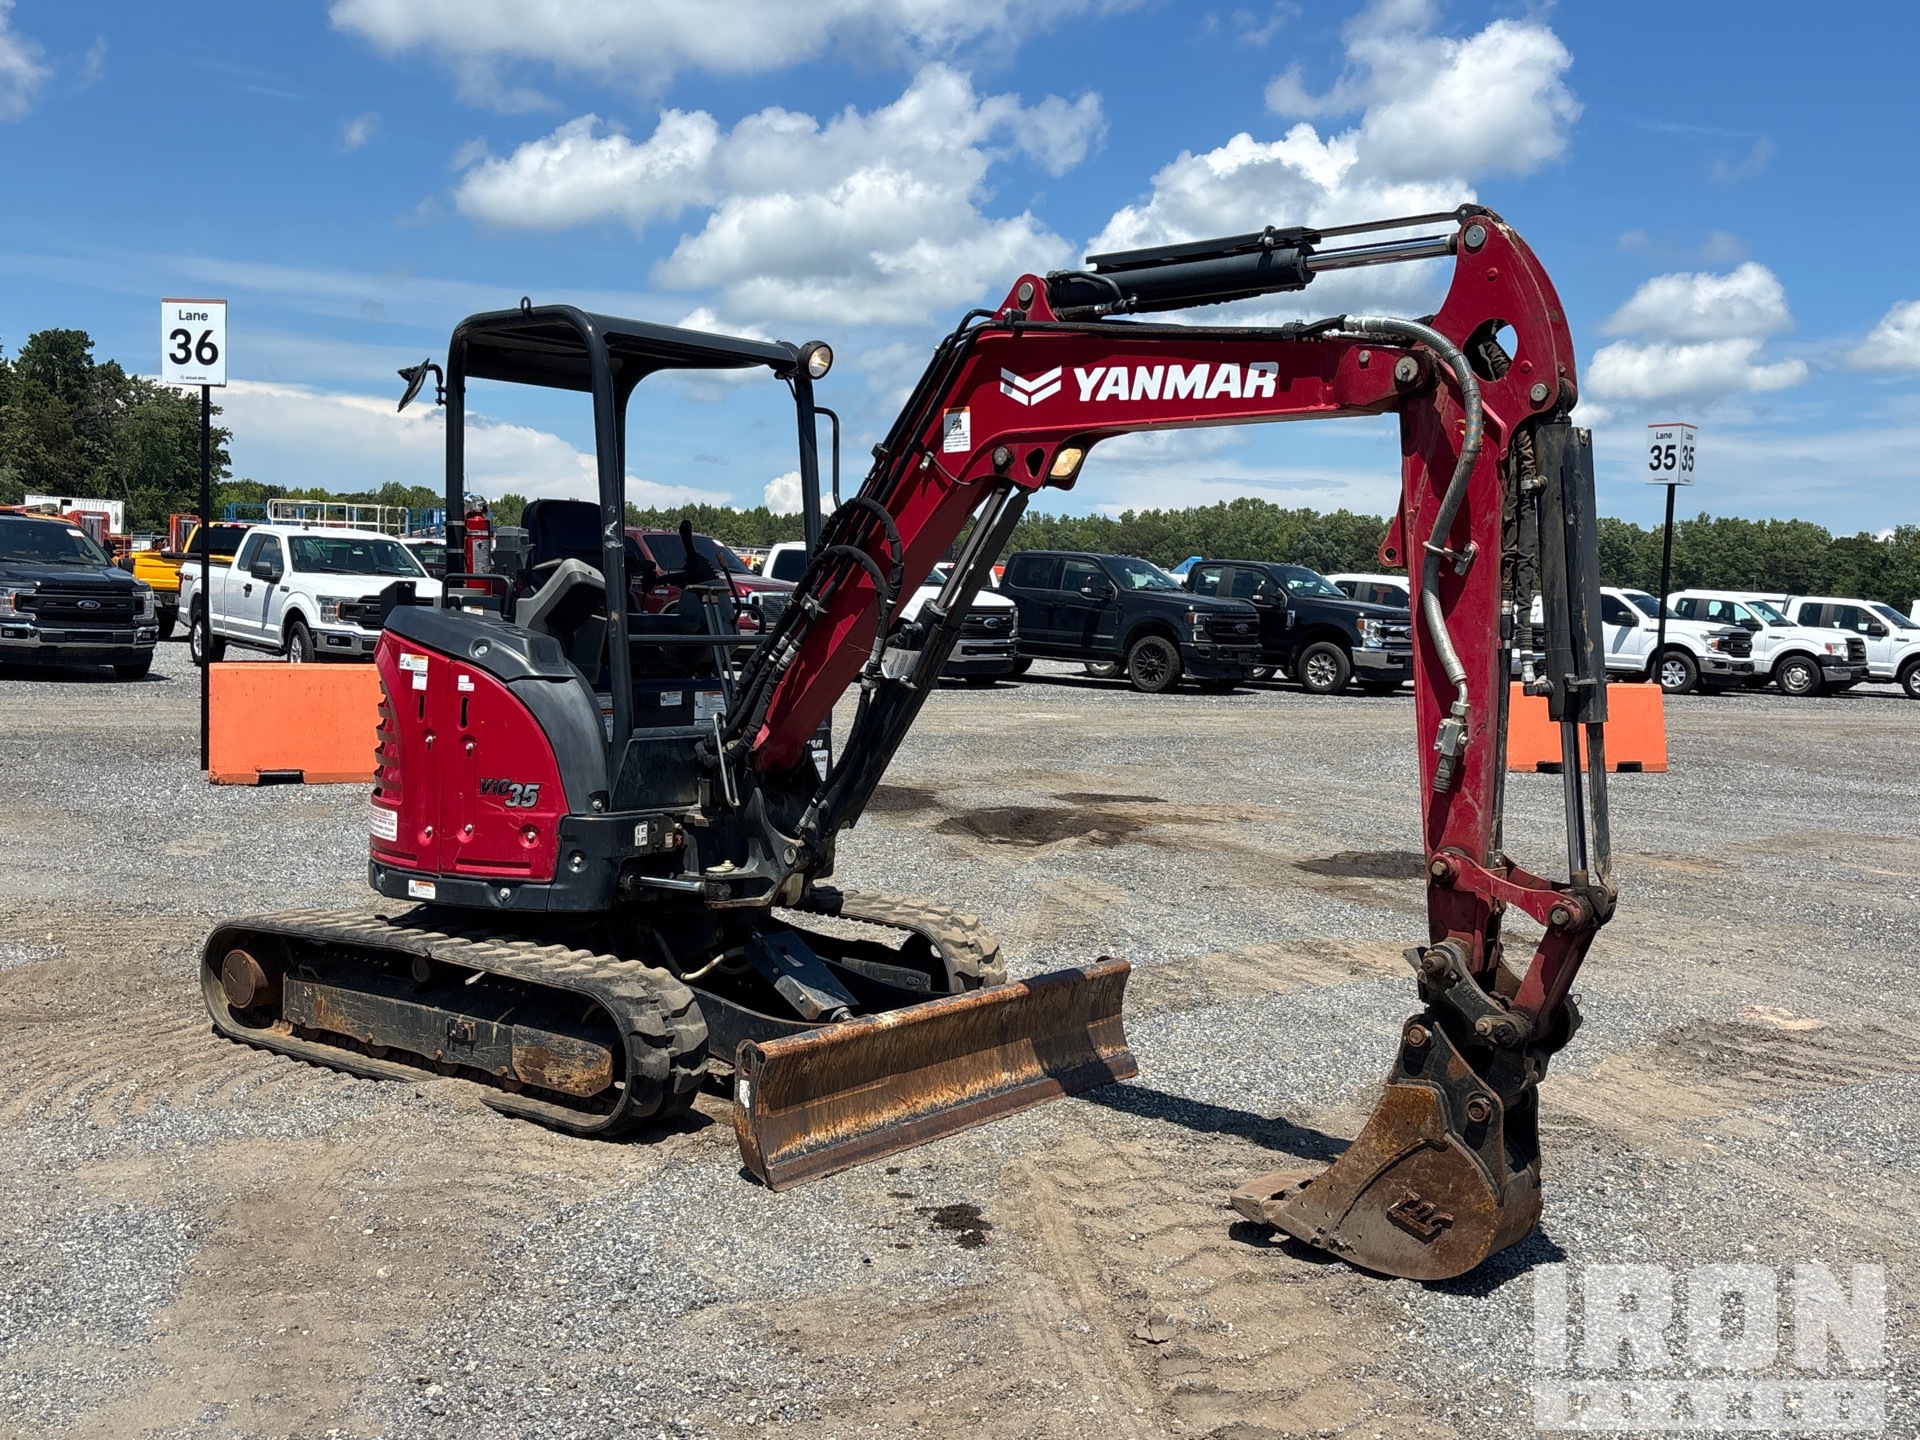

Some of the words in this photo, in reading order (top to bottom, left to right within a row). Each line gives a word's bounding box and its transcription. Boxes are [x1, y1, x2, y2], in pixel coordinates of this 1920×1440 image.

[178, 309, 209, 321] Lane
[168, 327, 219, 366] 36
[1073, 361, 1279, 402] YANMAR
[1655, 431, 1673, 440] Lane
[1648, 444, 1677, 471] 35
[1681, 444, 1695, 473] 35
